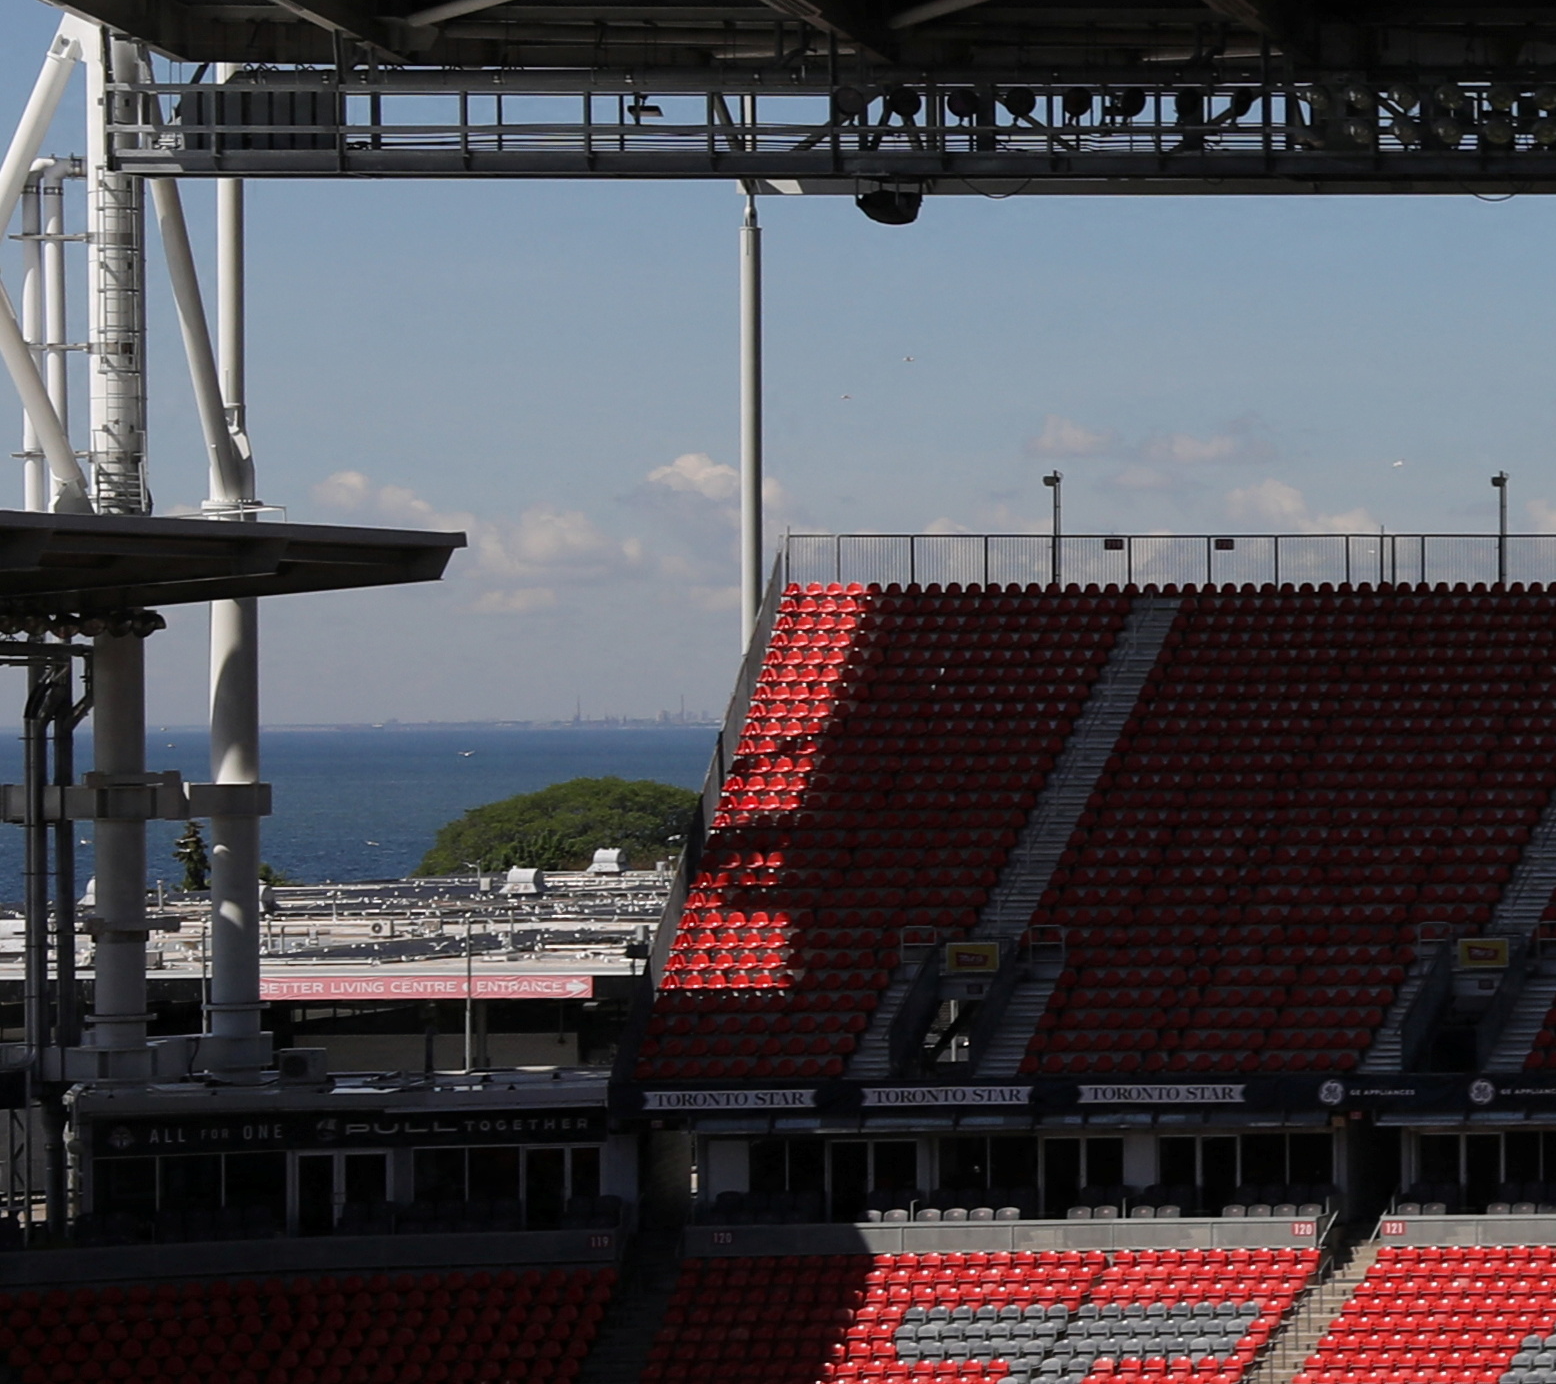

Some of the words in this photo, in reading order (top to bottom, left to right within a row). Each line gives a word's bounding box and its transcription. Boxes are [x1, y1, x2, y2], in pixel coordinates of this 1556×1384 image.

[259, 979, 324, 995] BETTER
[330, 980, 384, 994] LIVING
[390, 980, 457, 994] CENTRE
[476, 980, 562, 994] ENTRANCE
[653, 1091, 748, 1108] TORONTO
[754, 1090, 805, 1107] STAR
[873, 1088, 967, 1104] TORONTO
[973, 1087, 1023, 1103] STAR
[1088, 1085, 1181, 1101] TORONTO
[1187, 1085, 1235, 1101] STAR
[1364, 1088, 1416, 1096] APPLIANCES
[345, 1121, 458, 1135] PULL
[463, 1117, 589, 1133] TOGETHER
[149, 1127, 187, 1145] ALL
[200, 1128, 228, 1139] FOR
[242, 1124, 284, 1140] ONE
[1294, 1223, 1311, 1235] 120
[1386, 1222, 1403, 1234] 121
[591, 1236, 609, 1247] 119
[713, 1232, 732, 1244] 120
